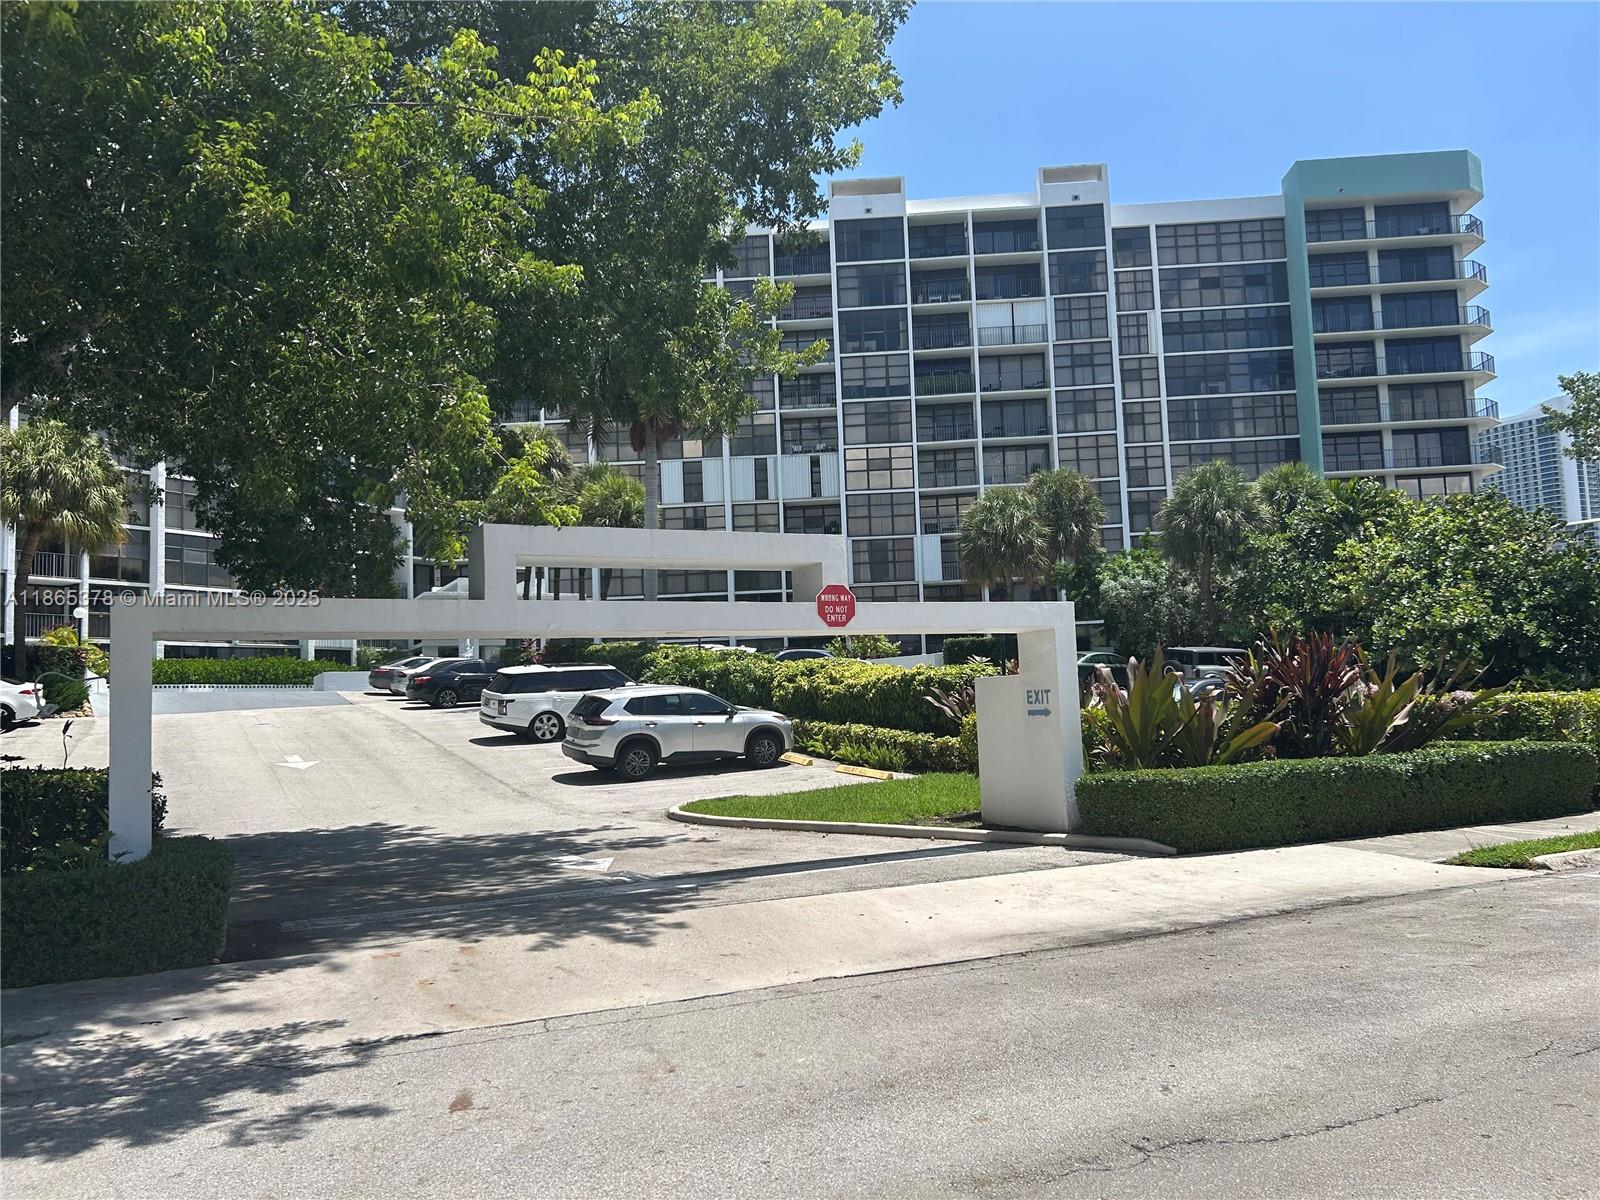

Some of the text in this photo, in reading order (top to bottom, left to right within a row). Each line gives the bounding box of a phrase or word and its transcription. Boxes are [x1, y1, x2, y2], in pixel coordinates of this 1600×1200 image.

[820, 594, 851, 602] WRONG WAY
[824, 605, 848, 613] DO NOT
[826, 614, 847, 622] ENTER
[1026, 689, 1051, 705] EXIT
